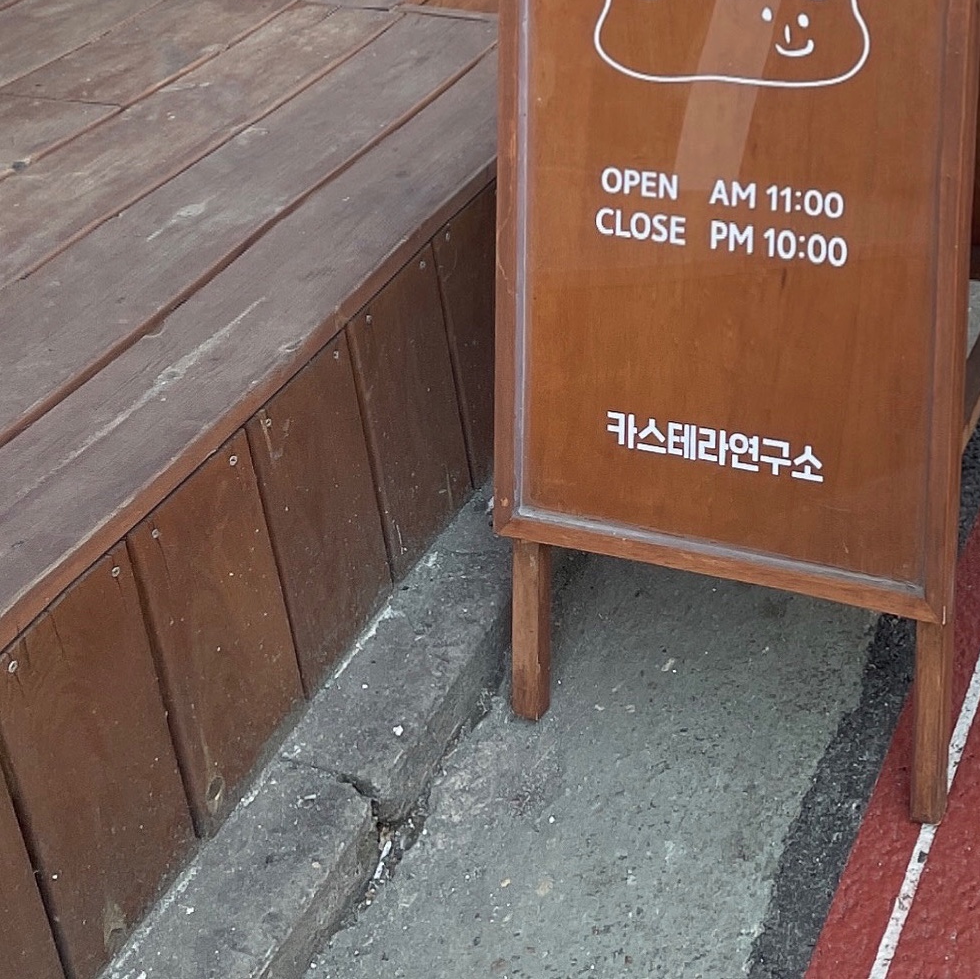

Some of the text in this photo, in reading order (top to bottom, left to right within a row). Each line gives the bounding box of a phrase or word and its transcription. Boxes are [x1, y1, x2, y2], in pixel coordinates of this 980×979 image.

[601, 167, 844, 219] OPEN AM 11:00
[595, 207, 848, 267] CLOSE PM 10:00
[606, 411, 824, 483] 카스테라연구소
